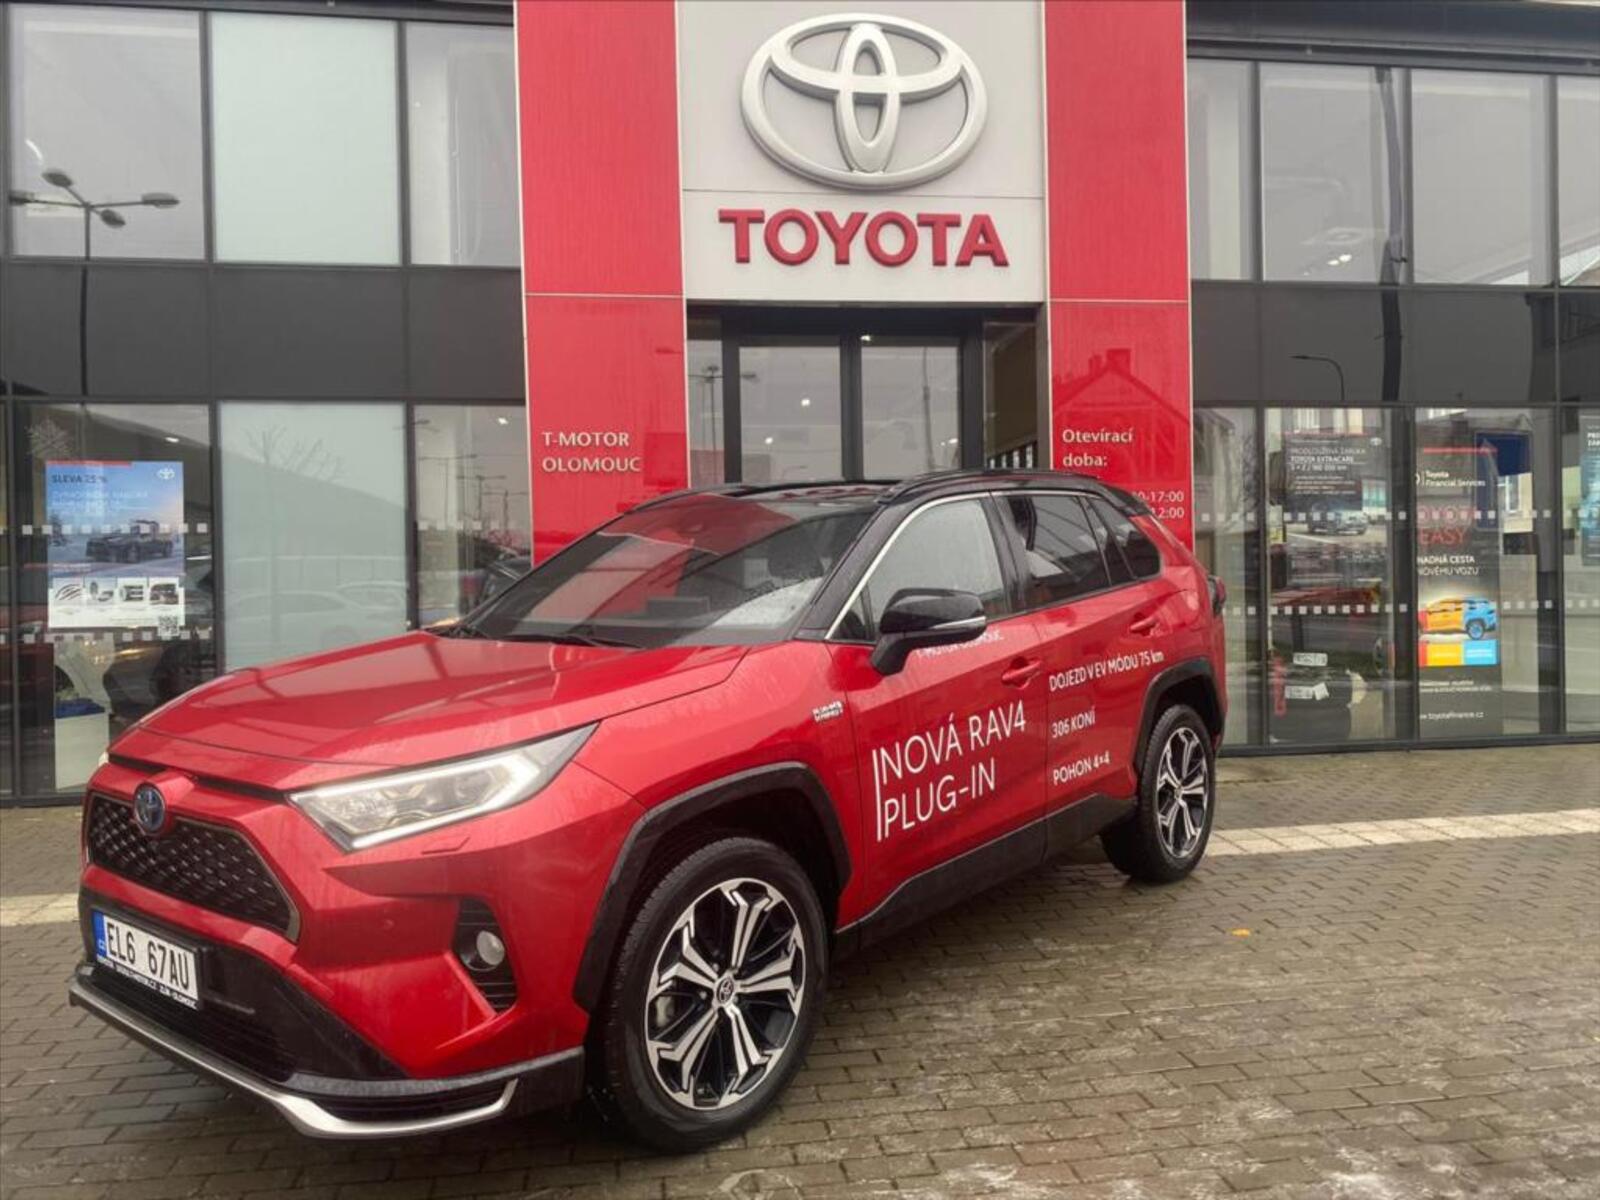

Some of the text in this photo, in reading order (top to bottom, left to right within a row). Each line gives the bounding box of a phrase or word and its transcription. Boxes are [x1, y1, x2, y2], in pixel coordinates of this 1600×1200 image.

[718, 208, 1009, 267] TOYOTA
[542, 432, 629, 446] T-MOTOR
[1062, 427, 1133, 443] Otevírací
[542, 457, 641, 472] OLOMOUC
[1062, 452, 1107, 467] doba:
[1458, 479, 1486, 487] Services
[1132, 491, 1184, 502] 0-17:00
[1417, 555, 1476, 564] NADNÁ CESTA
[1455, 566, 1480, 575] VOZU
[1049, 667, 1087, 692] DOJEZD
[1094, 659, 1107, 679] EV
[1107, 653, 1139, 675] MÓDU
[1138, 650, 1151, 667] 75
[1150, 649, 1165, 664] km
[1052, 705, 1096, 739] 306 KONÍ
[879, 699, 1027, 785] NOVÁ RAV4
[1053, 756, 1093, 786] POHON
[884, 757, 996, 838] PLUG-IN
[107, 922, 136, 965] EL6
[147, 940, 190, 991] 67AU
